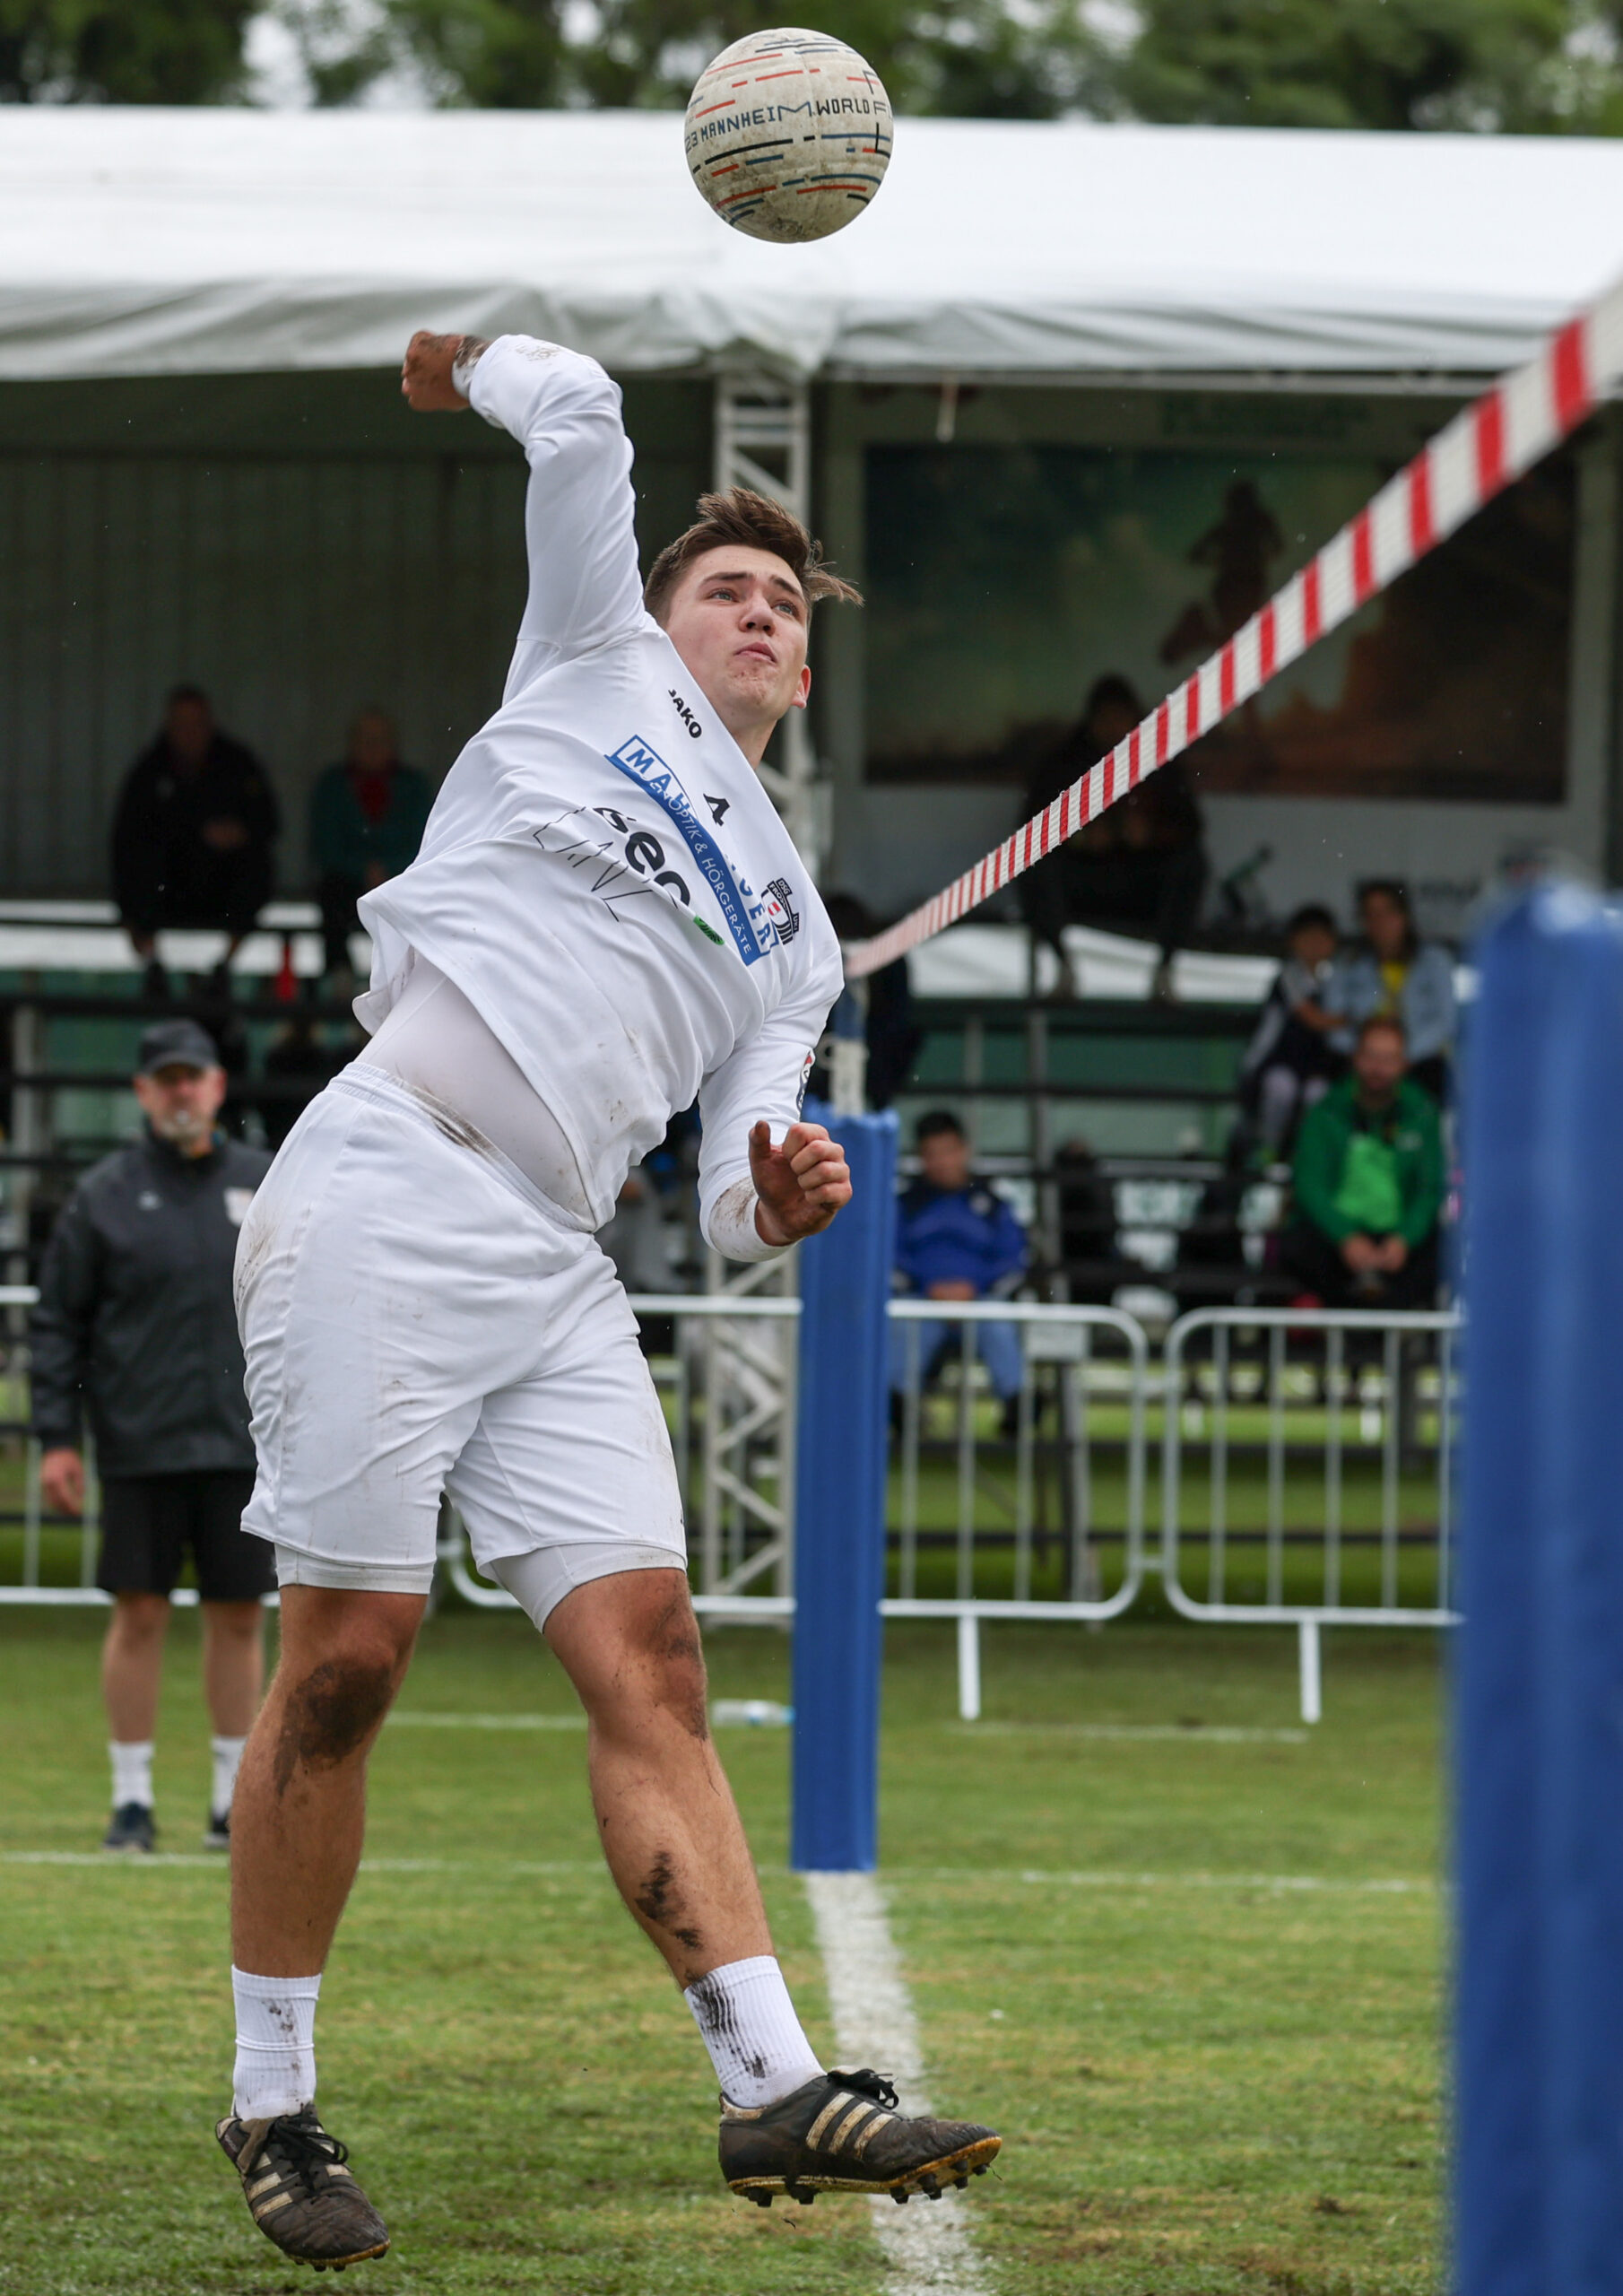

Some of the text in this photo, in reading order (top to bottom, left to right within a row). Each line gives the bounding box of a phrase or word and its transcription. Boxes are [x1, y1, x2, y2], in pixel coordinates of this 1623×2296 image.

[700, 100, 812, 143] MANNHEIM
[816, 97, 871, 117] WORLD
[701, 857, 752, 955] HÖRGERÄTE
[777, 880, 790, 896] DSG
